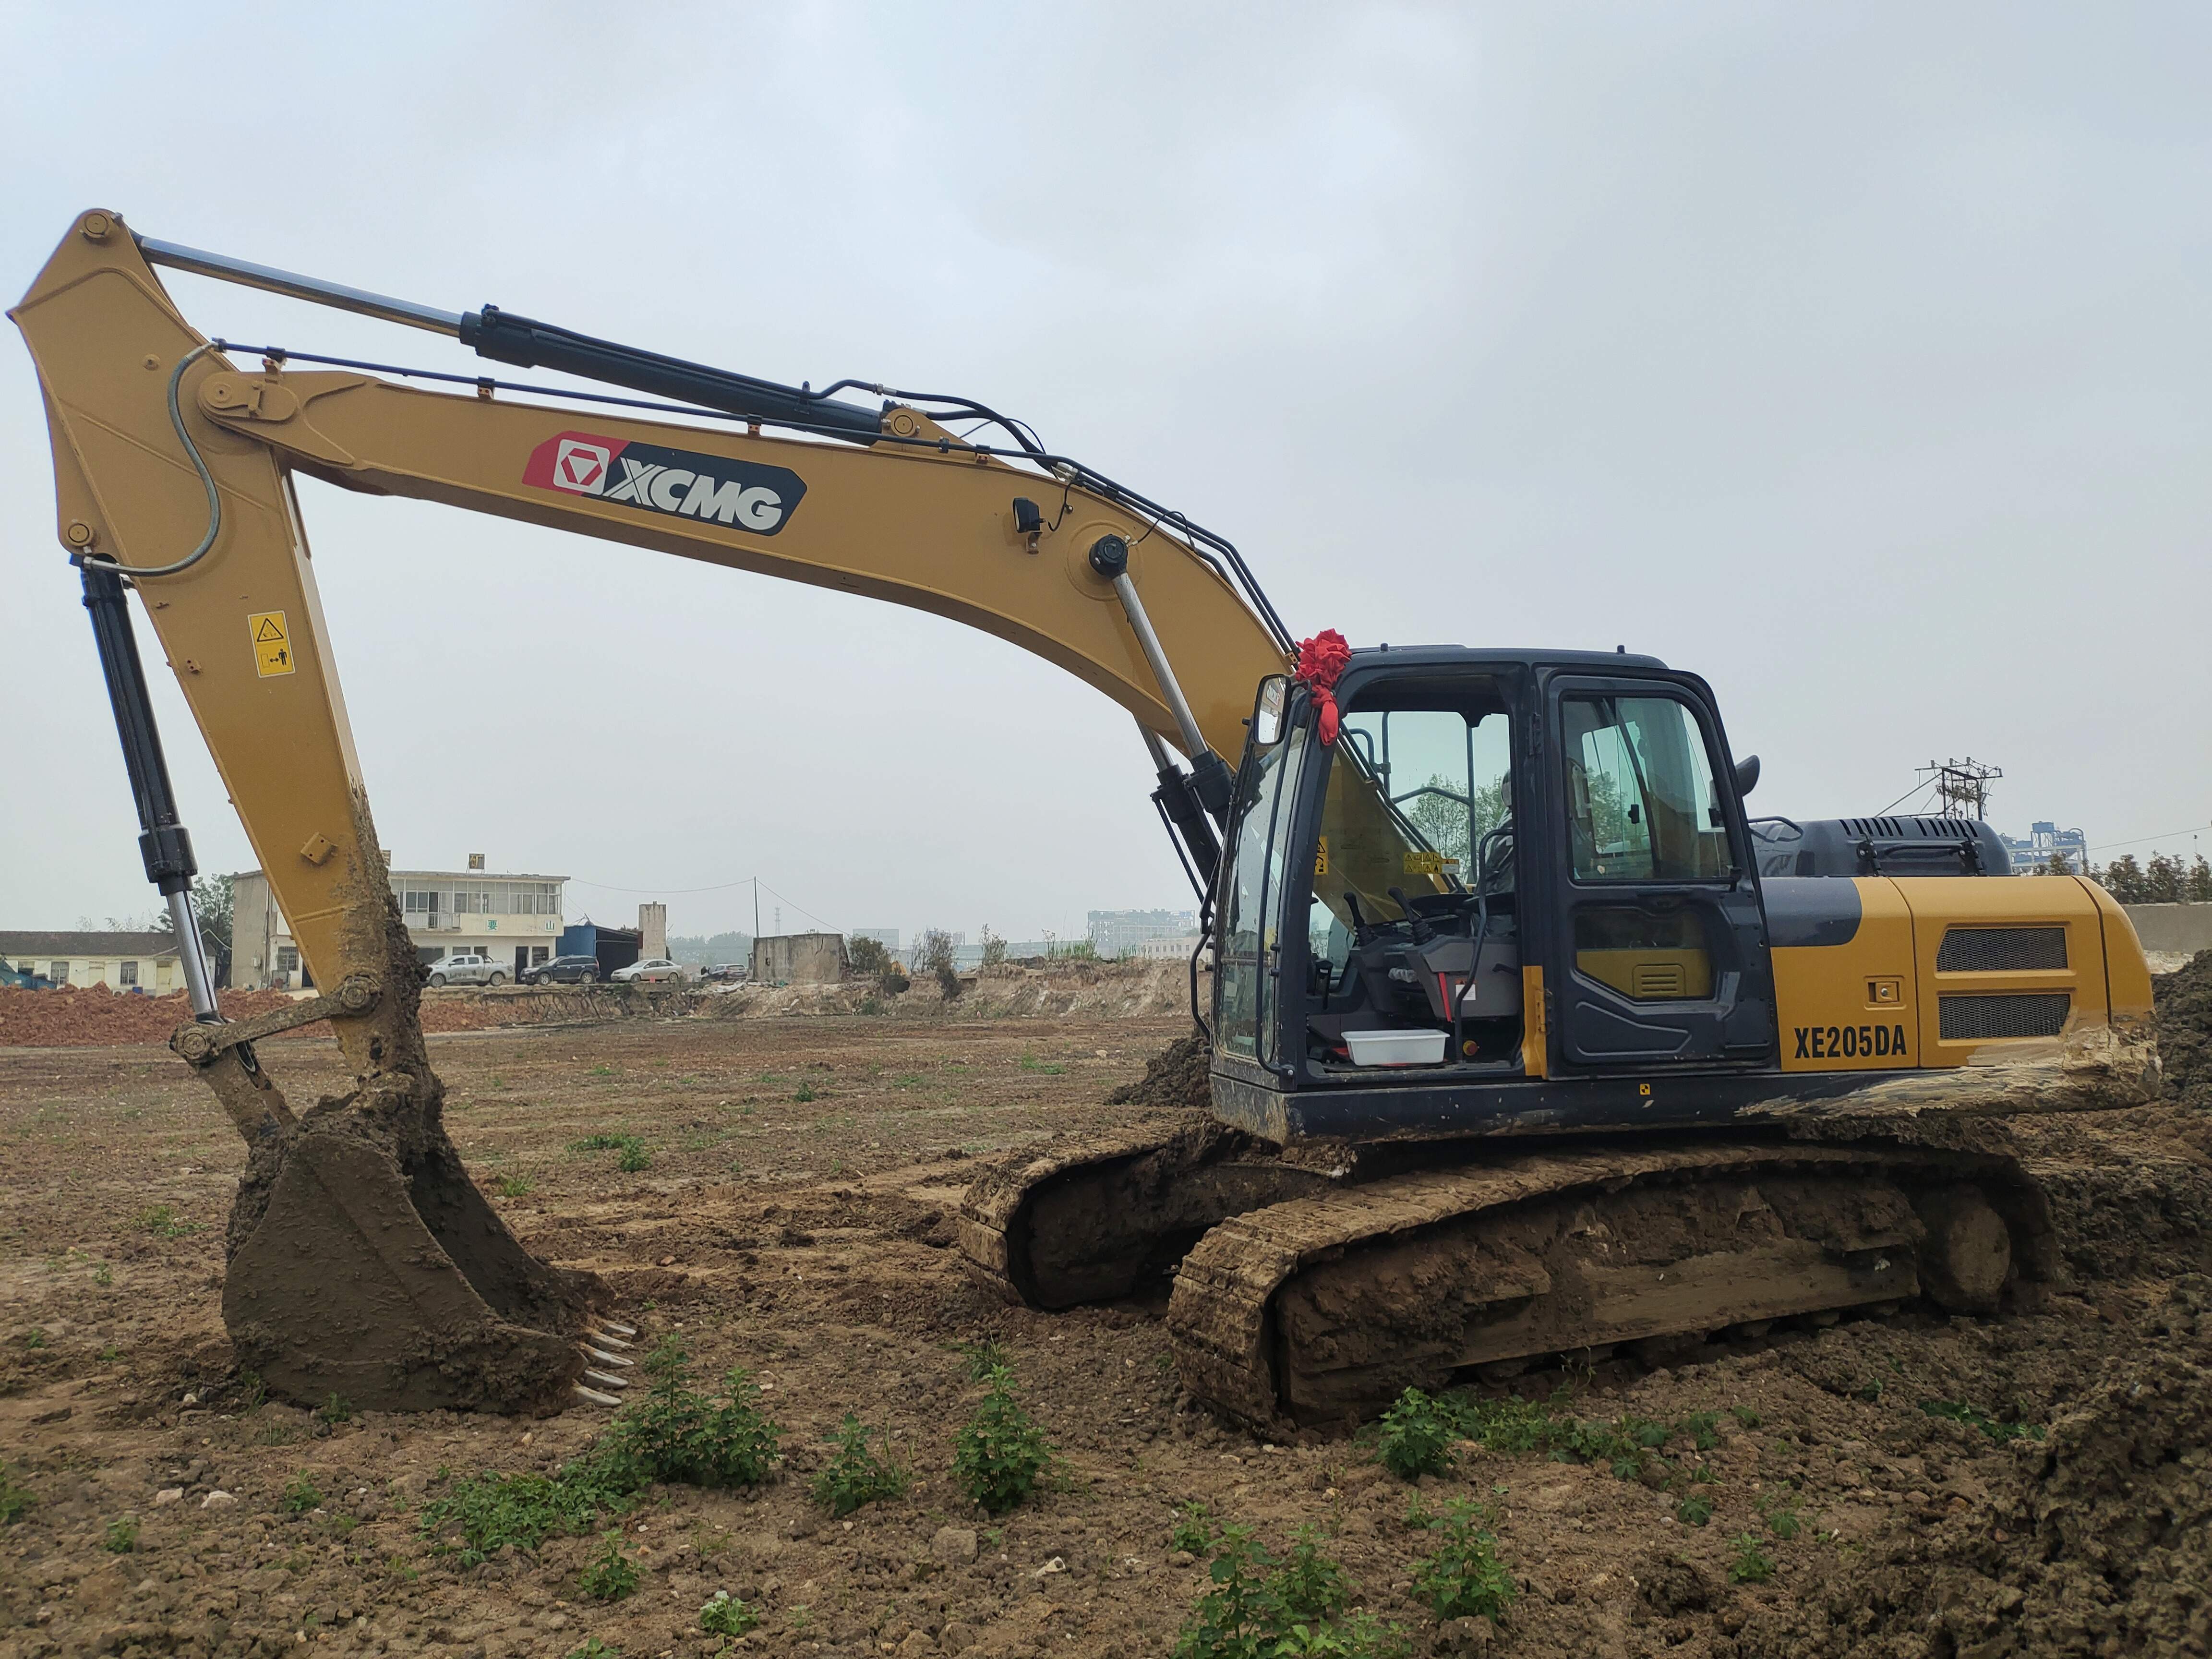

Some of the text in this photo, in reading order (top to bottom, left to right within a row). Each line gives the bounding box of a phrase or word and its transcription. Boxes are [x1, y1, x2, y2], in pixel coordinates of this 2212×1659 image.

[602, 457, 782, 530] XCMG
[546, 920, 555, 930] 山
[1794, 1025, 1907, 1058] XE205DA
